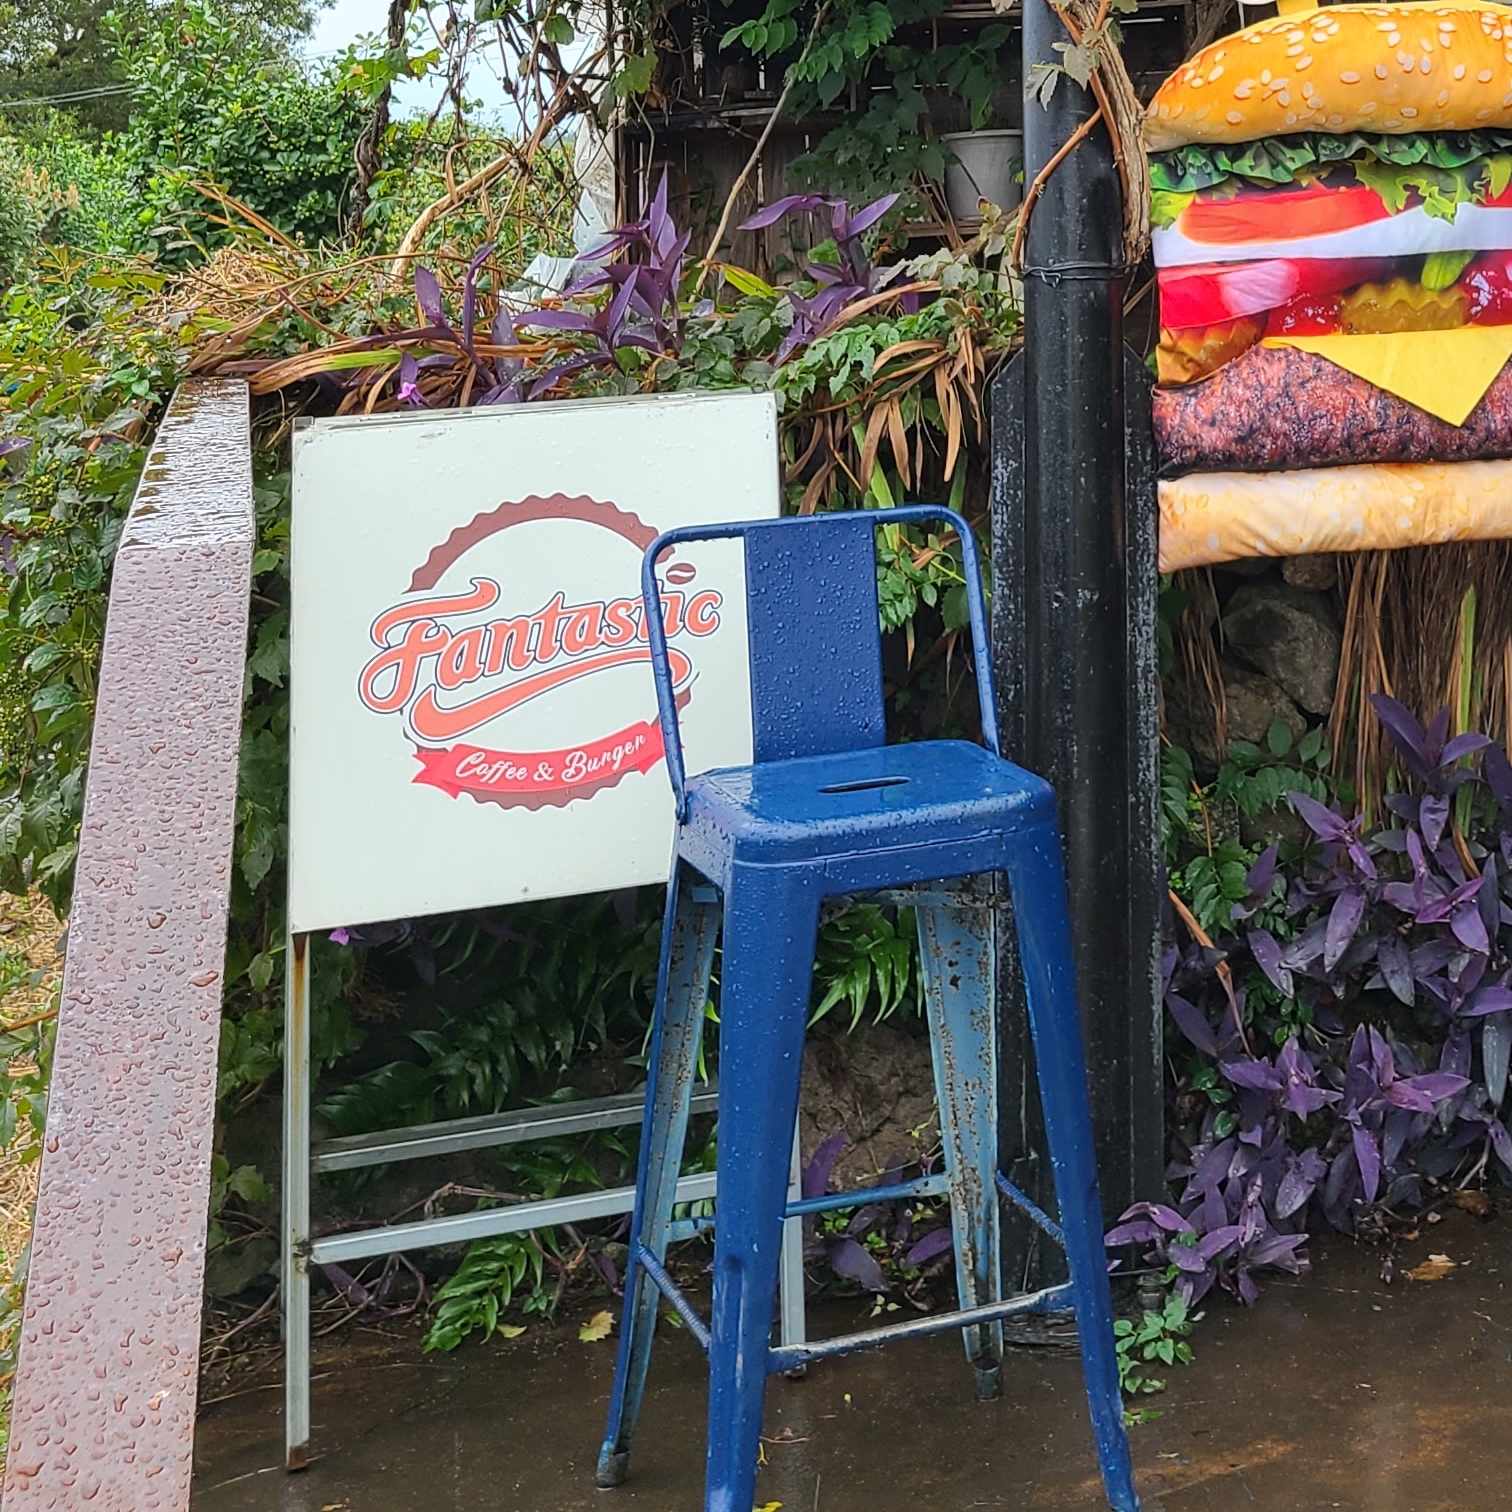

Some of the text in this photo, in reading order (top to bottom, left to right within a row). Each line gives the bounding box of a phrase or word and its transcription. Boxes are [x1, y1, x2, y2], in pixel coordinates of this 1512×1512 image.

[455, 734, 646, 784] Coffee & Burger
